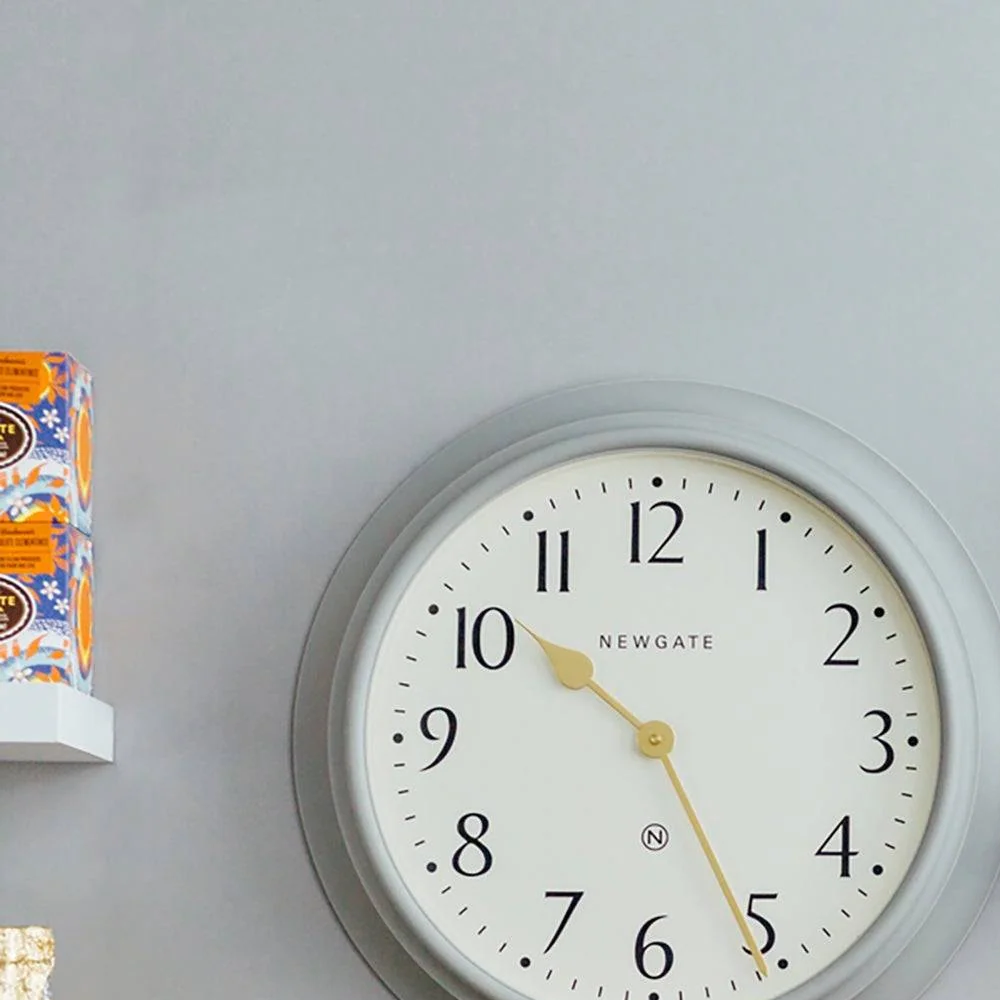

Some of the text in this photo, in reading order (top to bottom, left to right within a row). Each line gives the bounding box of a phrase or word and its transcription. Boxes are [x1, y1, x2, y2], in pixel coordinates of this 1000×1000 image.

[536, 530, 571, 592] 11
[629, 501, 685, 564] 12
[755, 529, 768, 591] 1
[455, 606, 516, 670] 10
[599, 634, 715, 650] NEWGATE
[823, 603, 861, 666] 2
[419, 706, 458, 772] 9
[858, 709, 896, 774] 3
[451, 812, 493, 877] 8
[814, 815, 860, 878] 4
[543, 891, 584, 955] 7
[634, 915, 675, 980] 6
[742, 893, 779, 956] 5
